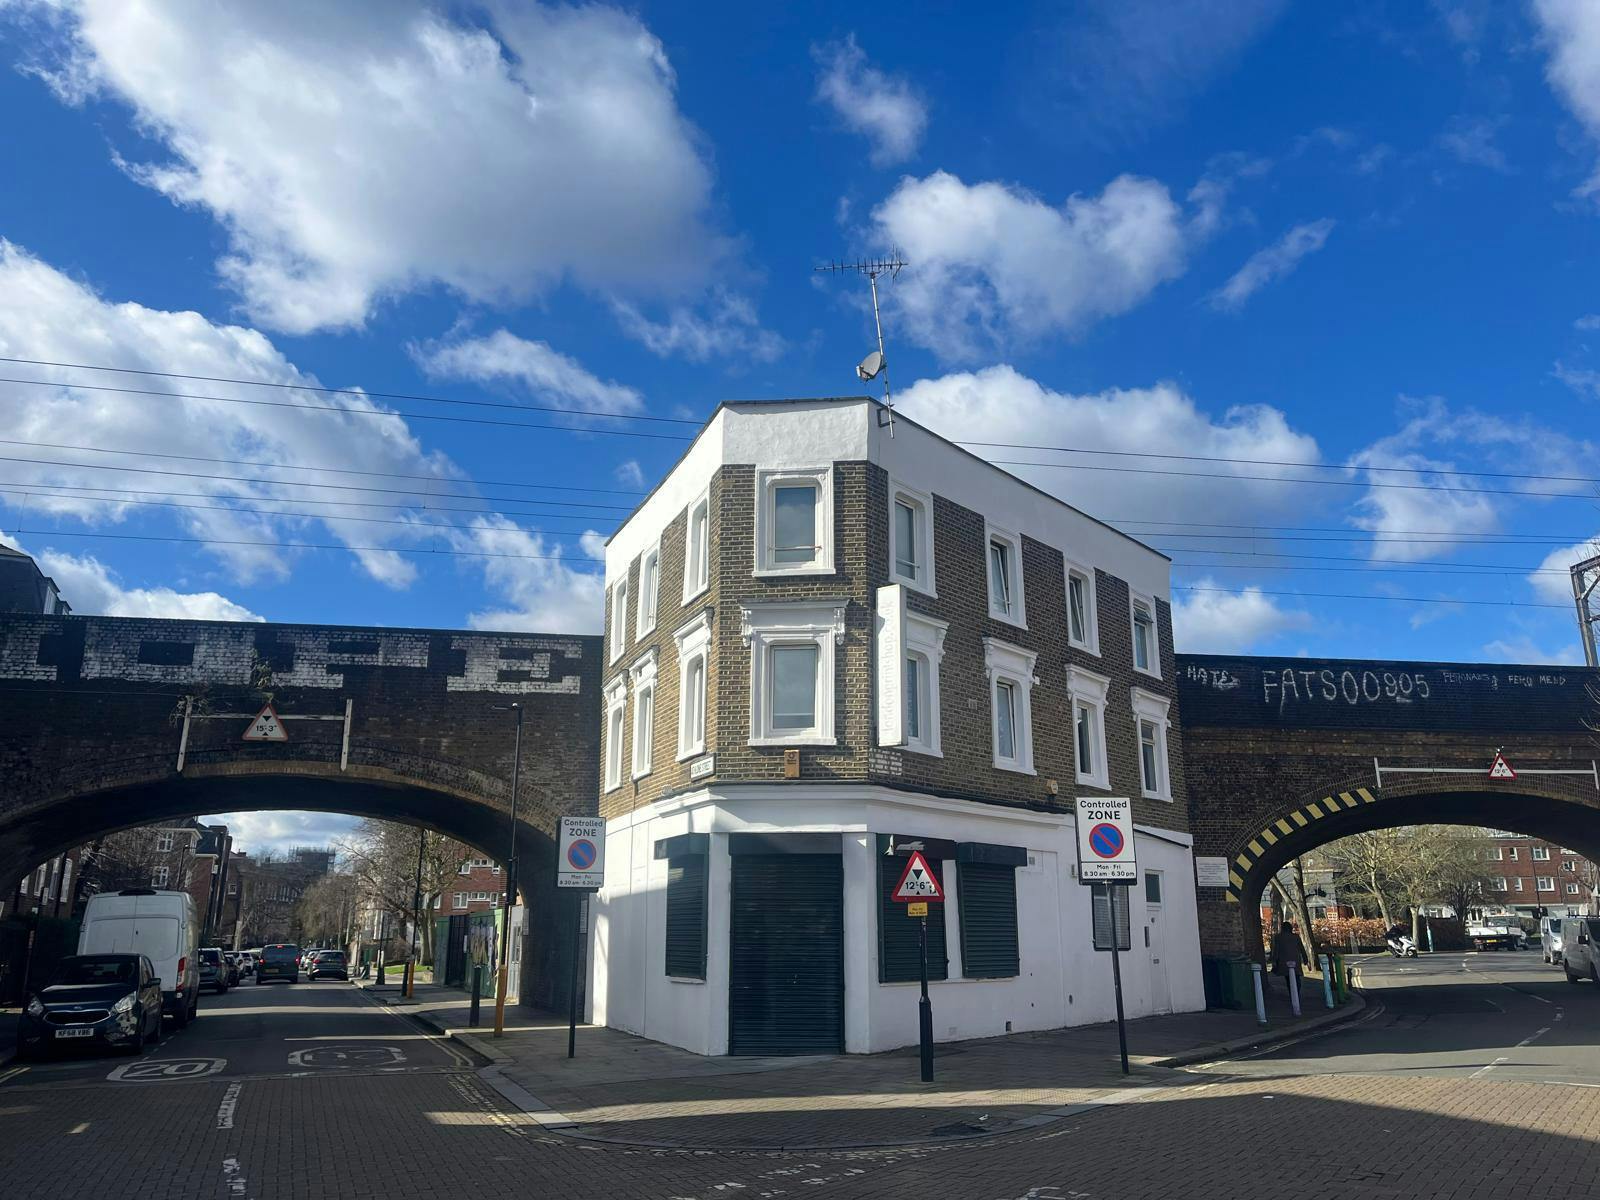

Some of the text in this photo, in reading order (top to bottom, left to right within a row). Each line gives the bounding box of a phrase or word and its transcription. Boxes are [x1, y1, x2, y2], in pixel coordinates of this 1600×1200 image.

[1080, 800, 1127, 808] Controlled
[1088, 811, 1121, 820] ZONE
[564, 819, 603, 827] Controlled
[569, 828, 597, 837] ZONE
[129, 1063, 208, 1077] 20
